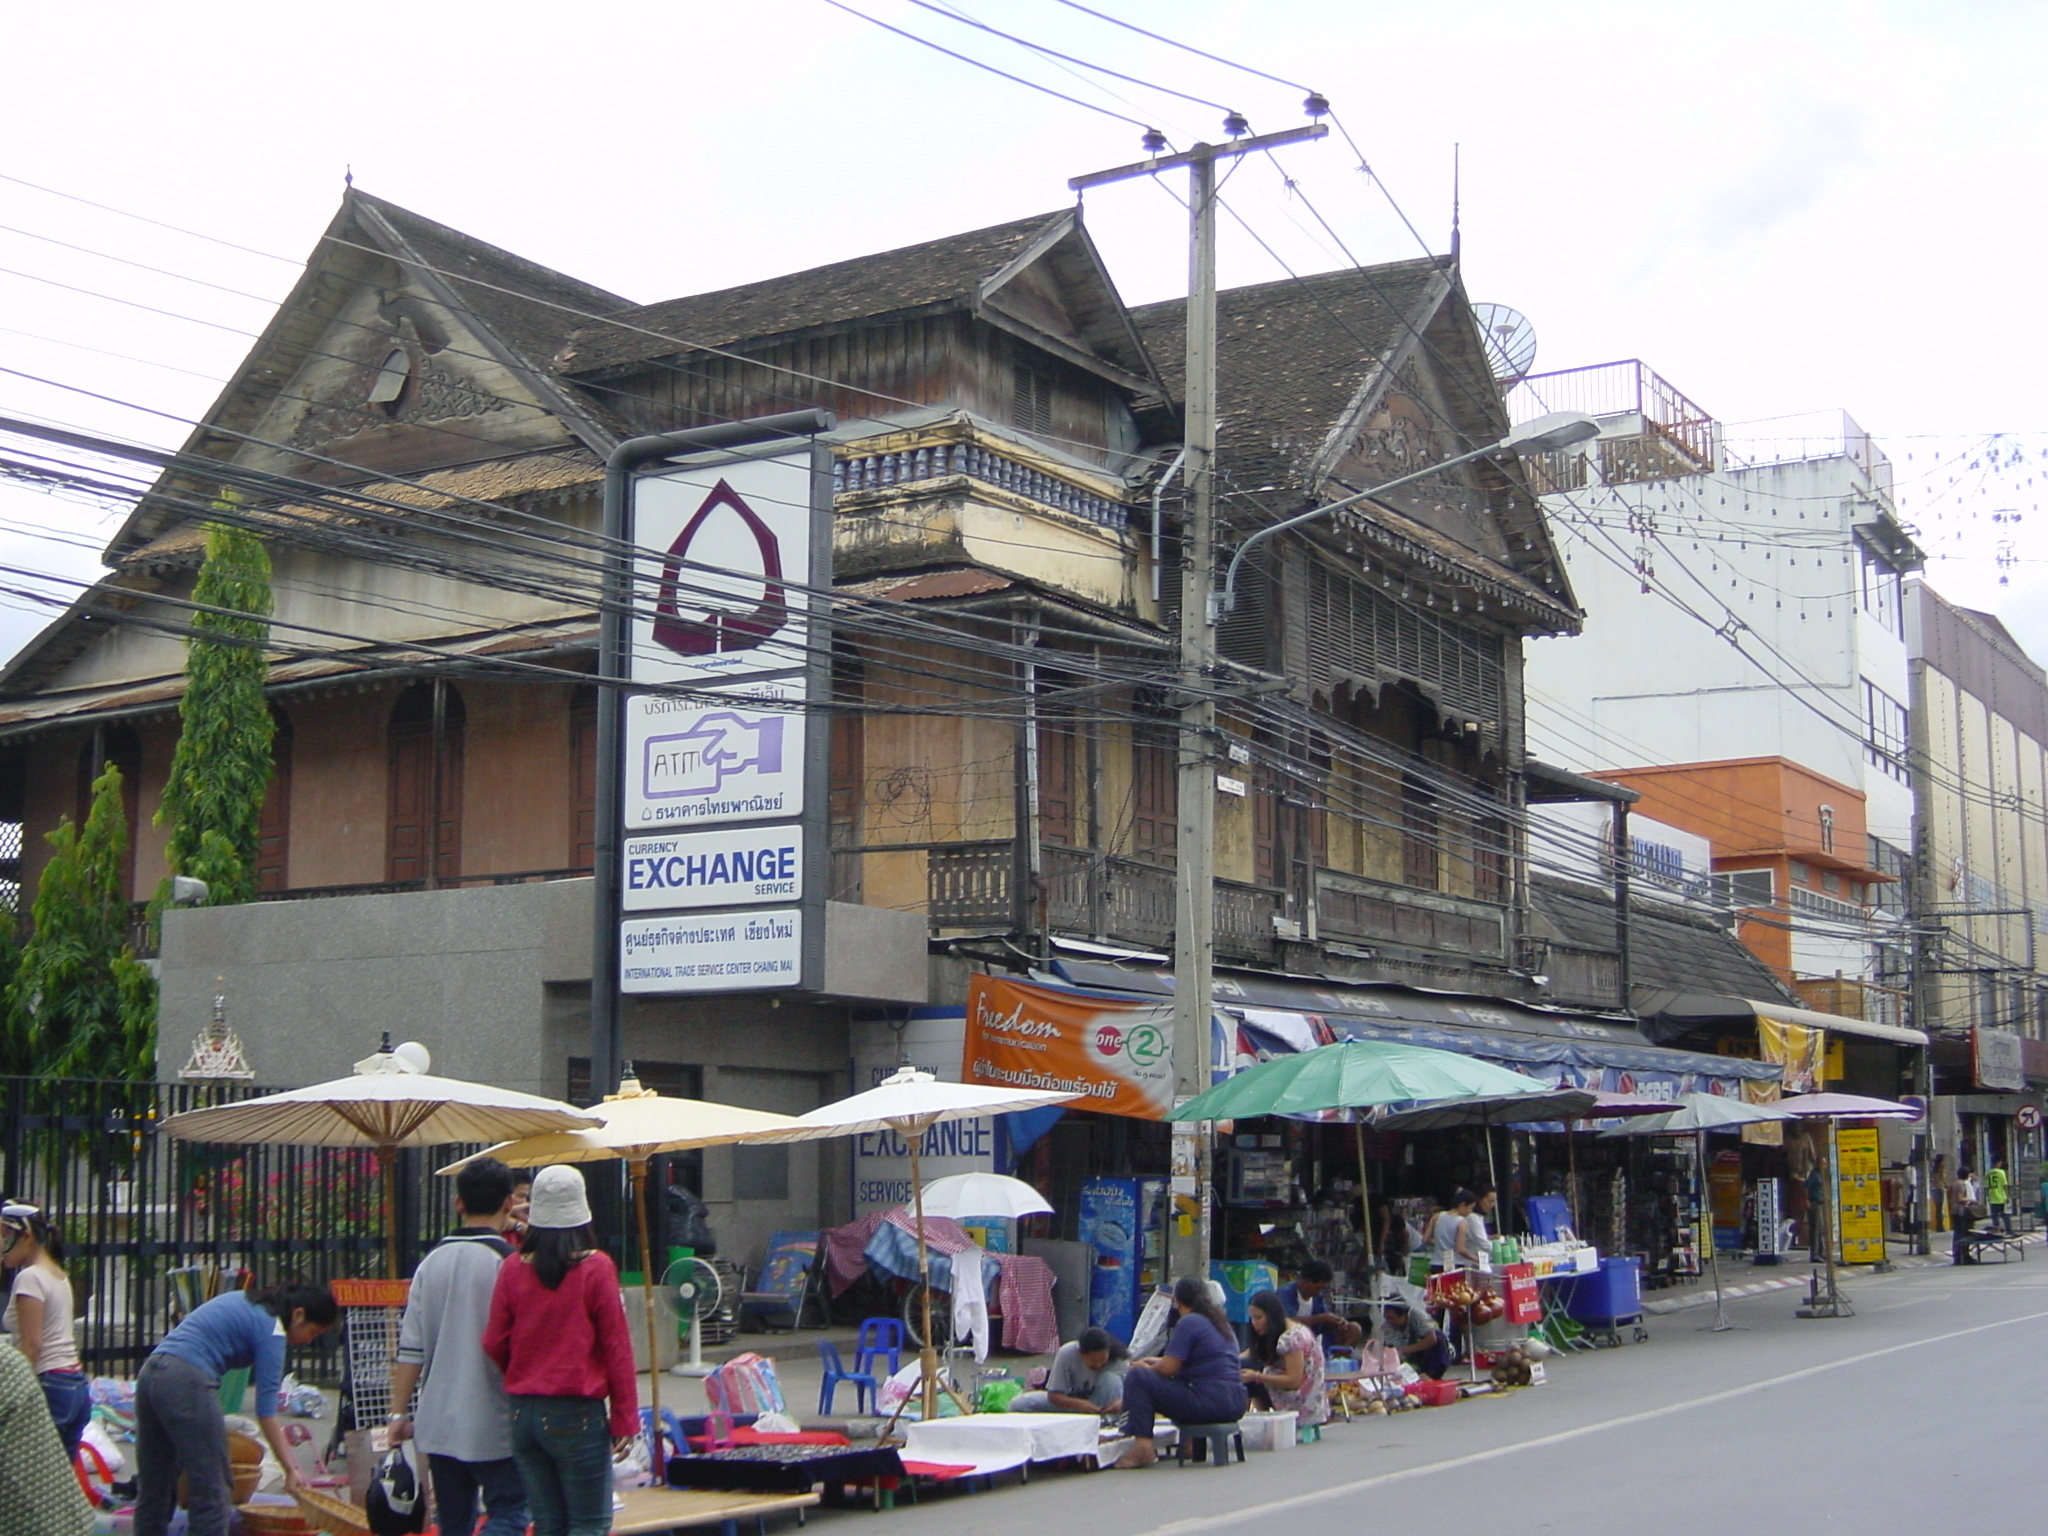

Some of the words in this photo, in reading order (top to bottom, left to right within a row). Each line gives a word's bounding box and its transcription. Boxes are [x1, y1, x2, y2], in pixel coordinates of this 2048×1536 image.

[654, 751, 701, 777] ATM
[655, 792, 784, 820] ธนาคารไทยพาณิชย์
[628, 841, 679, 855] CURRENCY
[628, 846, 795, 890] EXCHANGE
[754, 882, 795, 896] SERVICE
[625, 926, 736, 955] ศูนย์ธุรกิจต่างประเทศ
[744, 918, 793, 940] เชียงใหม่
[624, 966, 673, 980] INTERNATIONAL
[674, 965, 696, 978] TRADE
[697, 963, 724, 977] SERVICE
[725, 962, 751, 975] CENTER
[779, 959, 793, 972] MAI
[1335, 992, 1391, 1013] PEPSI
[1466, 1007, 1512, 1025] PEPSI
[1095, 1032, 1123, 1048] one
[860, 1181, 913, 1202] SERVICE
[1760, 1183, 1770, 1250] INTERNET
[334, 1284, 365, 1302] THAI
[367, 1284, 408, 1302] FASHIO
